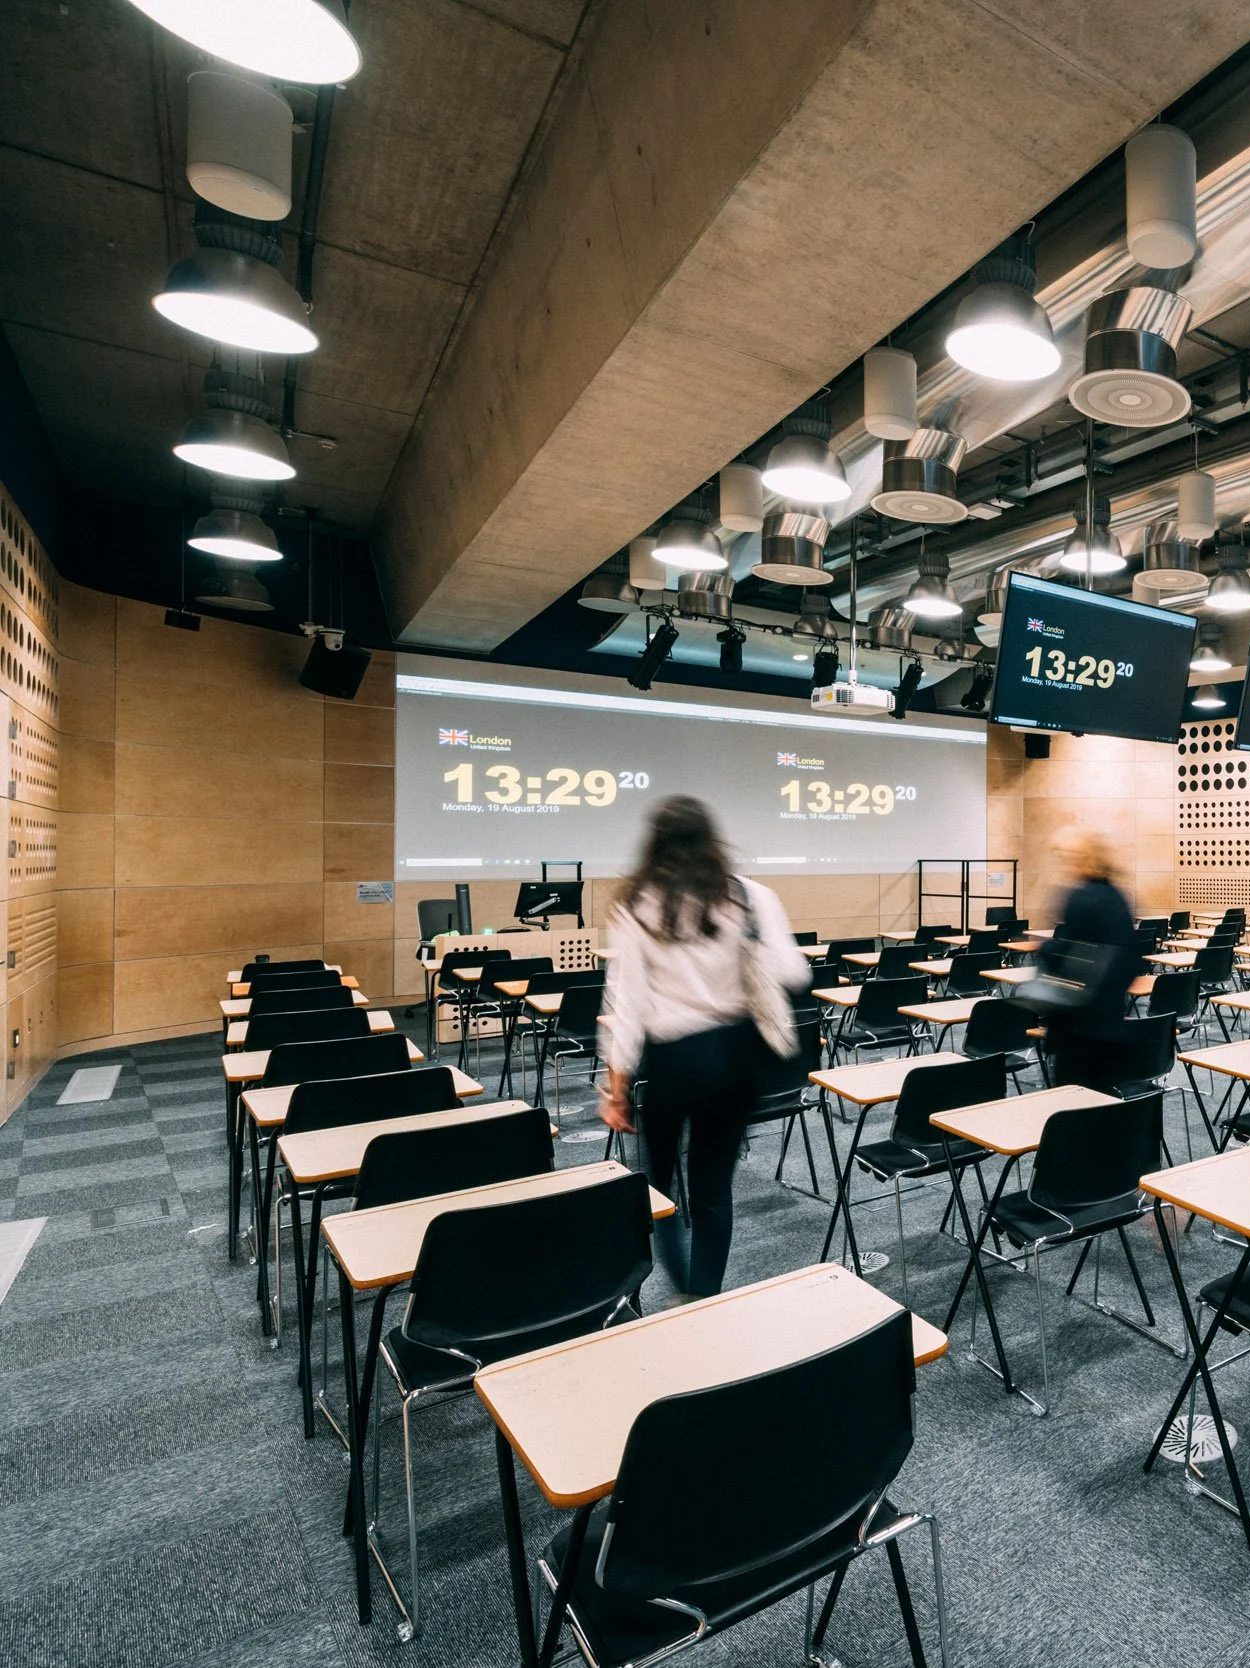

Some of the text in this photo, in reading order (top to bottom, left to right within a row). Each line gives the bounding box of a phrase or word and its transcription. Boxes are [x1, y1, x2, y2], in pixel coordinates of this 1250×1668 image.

[1042, 624, 1065, 635] London
[1025, 646, 1134, 689] 13:29 20
[1021, 675, 1044, 686] Monday,
[1052, 681, 1070, 689] August
[469, 734, 512, 746] London
[796, 757, 825, 766] London
[443, 763, 650, 807] 13:29 20
[780, 779, 917, 815] 13:29 20
[442, 802, 560, 814] Monday, 19 August 2019
[817, 813, 840, 821] August
